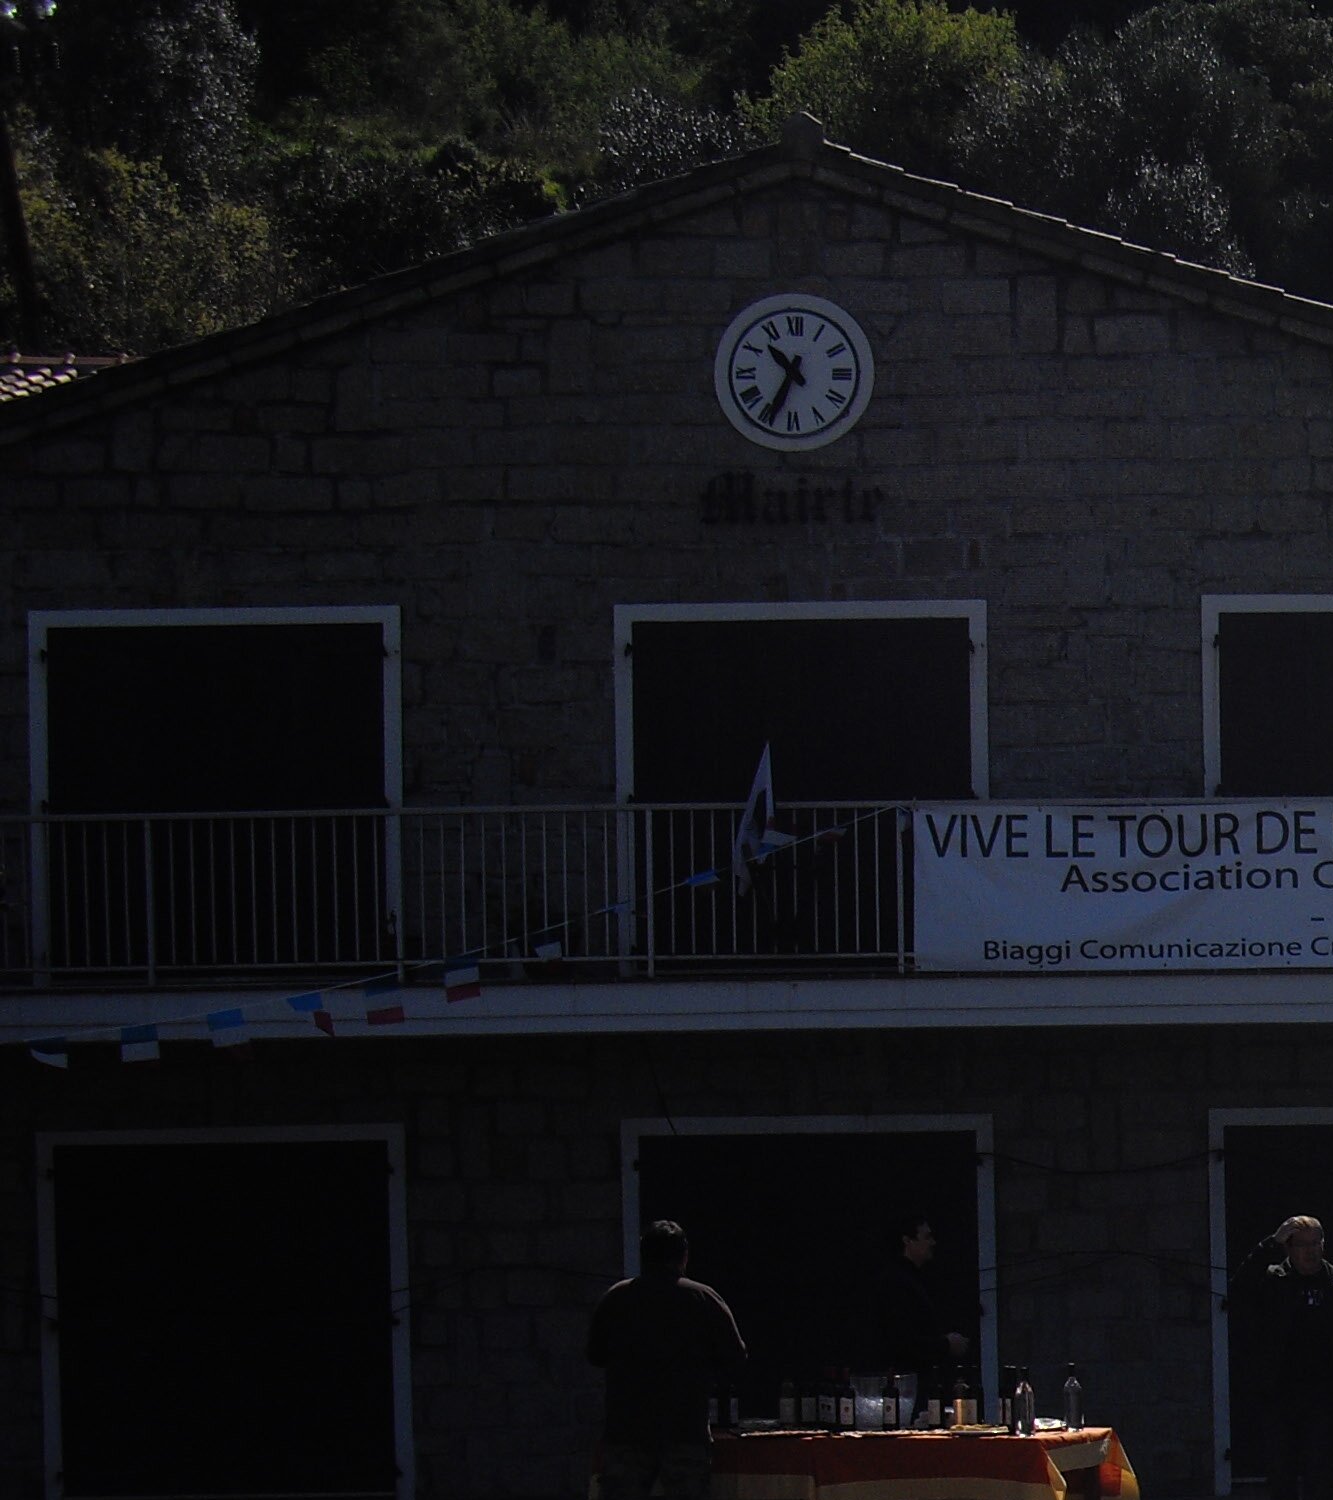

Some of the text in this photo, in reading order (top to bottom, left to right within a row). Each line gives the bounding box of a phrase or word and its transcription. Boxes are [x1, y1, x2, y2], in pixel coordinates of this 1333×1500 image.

[926, 814, 1029, 859] VIVE
[1045, 814, 1096, 859] LE
[1107, 812, 1241, 859] TOUR
[1256, 811, 1317, 855] DE
[1061, 862, 1299, 893] Association
[983, 940, 1071, 965] Biaggi
[1081, 937, 1302, 960] Comunicazione
